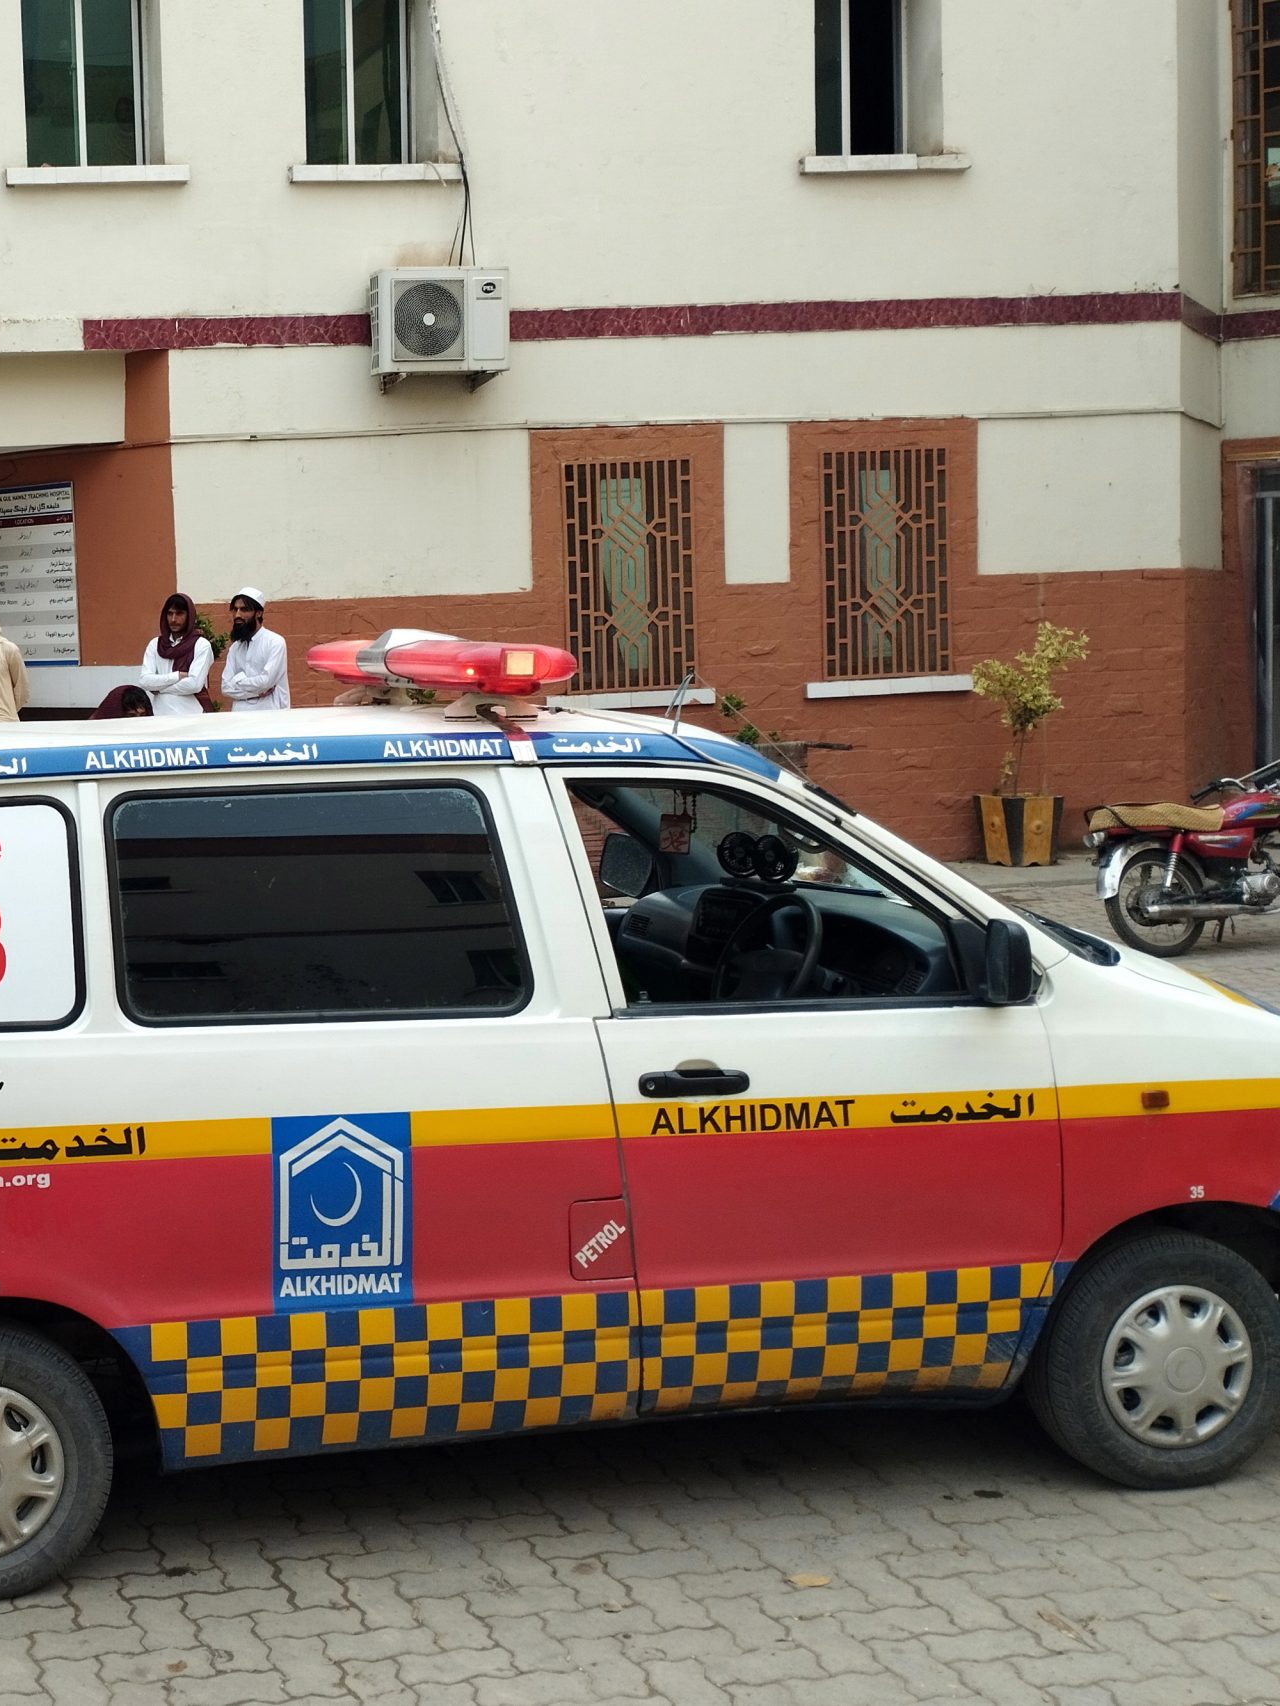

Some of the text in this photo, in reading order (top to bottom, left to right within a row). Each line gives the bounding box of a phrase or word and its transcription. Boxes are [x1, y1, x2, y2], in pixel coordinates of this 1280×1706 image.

[28, 491, 48, 500] TEACHING
[49, 489, 70, 498] HOSPITAL
[227, 743, 318, 763] الخدمت
[383, 739, 503, 758] ALKHIDMAT
[552, 736, 641, 754] الخدمت
[85, 746, 210, 769] ALKHIDMAT
[650, 1099, 856, 1136] ALKHIDMAT
[890, 1091, 1035, 1124] الخدمت
[1189, 1185, 1205, 1199] 35
[574, 1219, 626, 1269] PETROL
[279, 1272, 402, 1298] ALKHIDMAT
